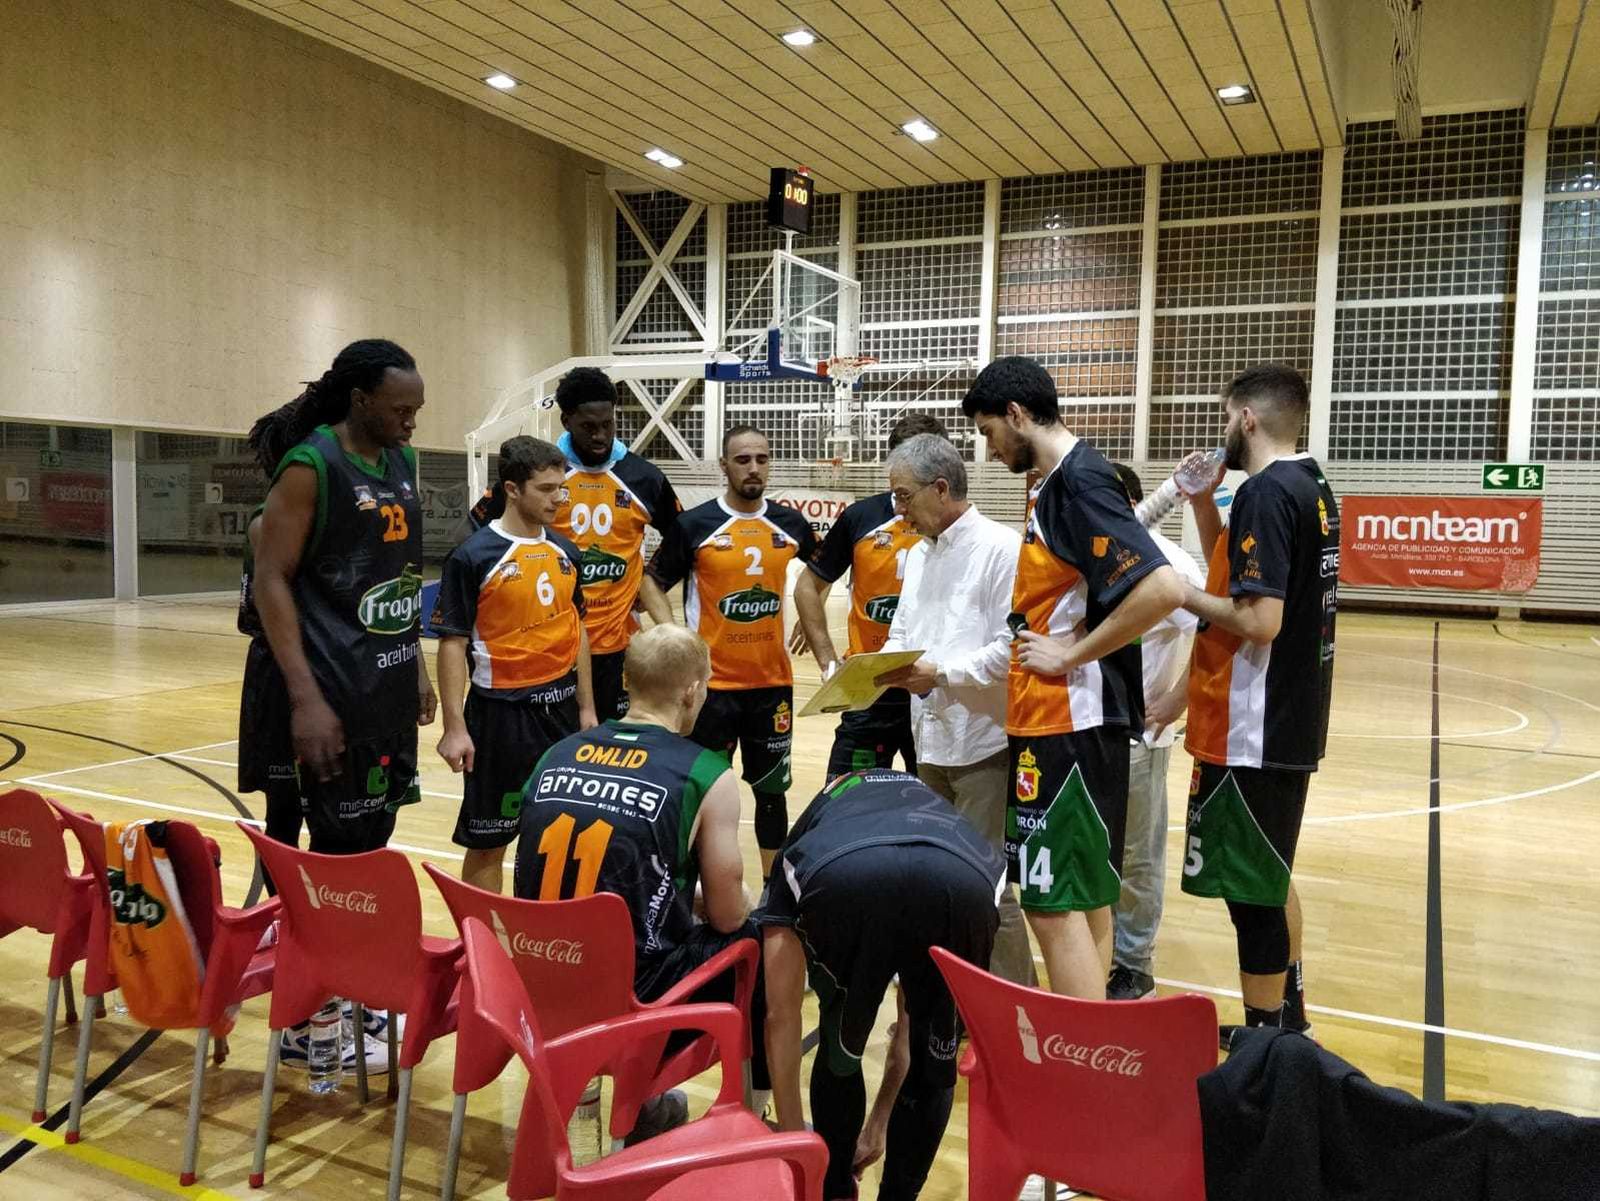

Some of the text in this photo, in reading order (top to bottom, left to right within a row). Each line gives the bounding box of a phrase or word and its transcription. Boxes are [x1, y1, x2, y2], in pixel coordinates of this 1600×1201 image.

[380, 504, 409, 542] 23
[571, 502, 613, 536] 00
[743, 546, 764, 576] 2
[1352, 543, 1386, 551] AGENCIA
[1388, 544, 1399, 552] DE
[1401, 545, 1449, 553] PUBLICIDAD
[1459, 546, 1525, 555] COMUNICACIÓN
[582, 561, 626, 580] gata
[1409, 567, 1464, 577] www.mcn.es
[536, 571, 555, 606] 6
[723, 594, 780, 617] Fragata
[377, 643, 419, 668] aceitun
[575, 743, 648, 769] OMLID
[537, 812, 615, 903] 11
[1018, 842, 1055, 894] 14
[1183, 834, 1204, 877] 5
[318, 884, 377, 914] Coca-Cola
[513, 931, 584, 965] Coca-Cola
[1043, 1033, 1148, 1077] Coca-Cola
